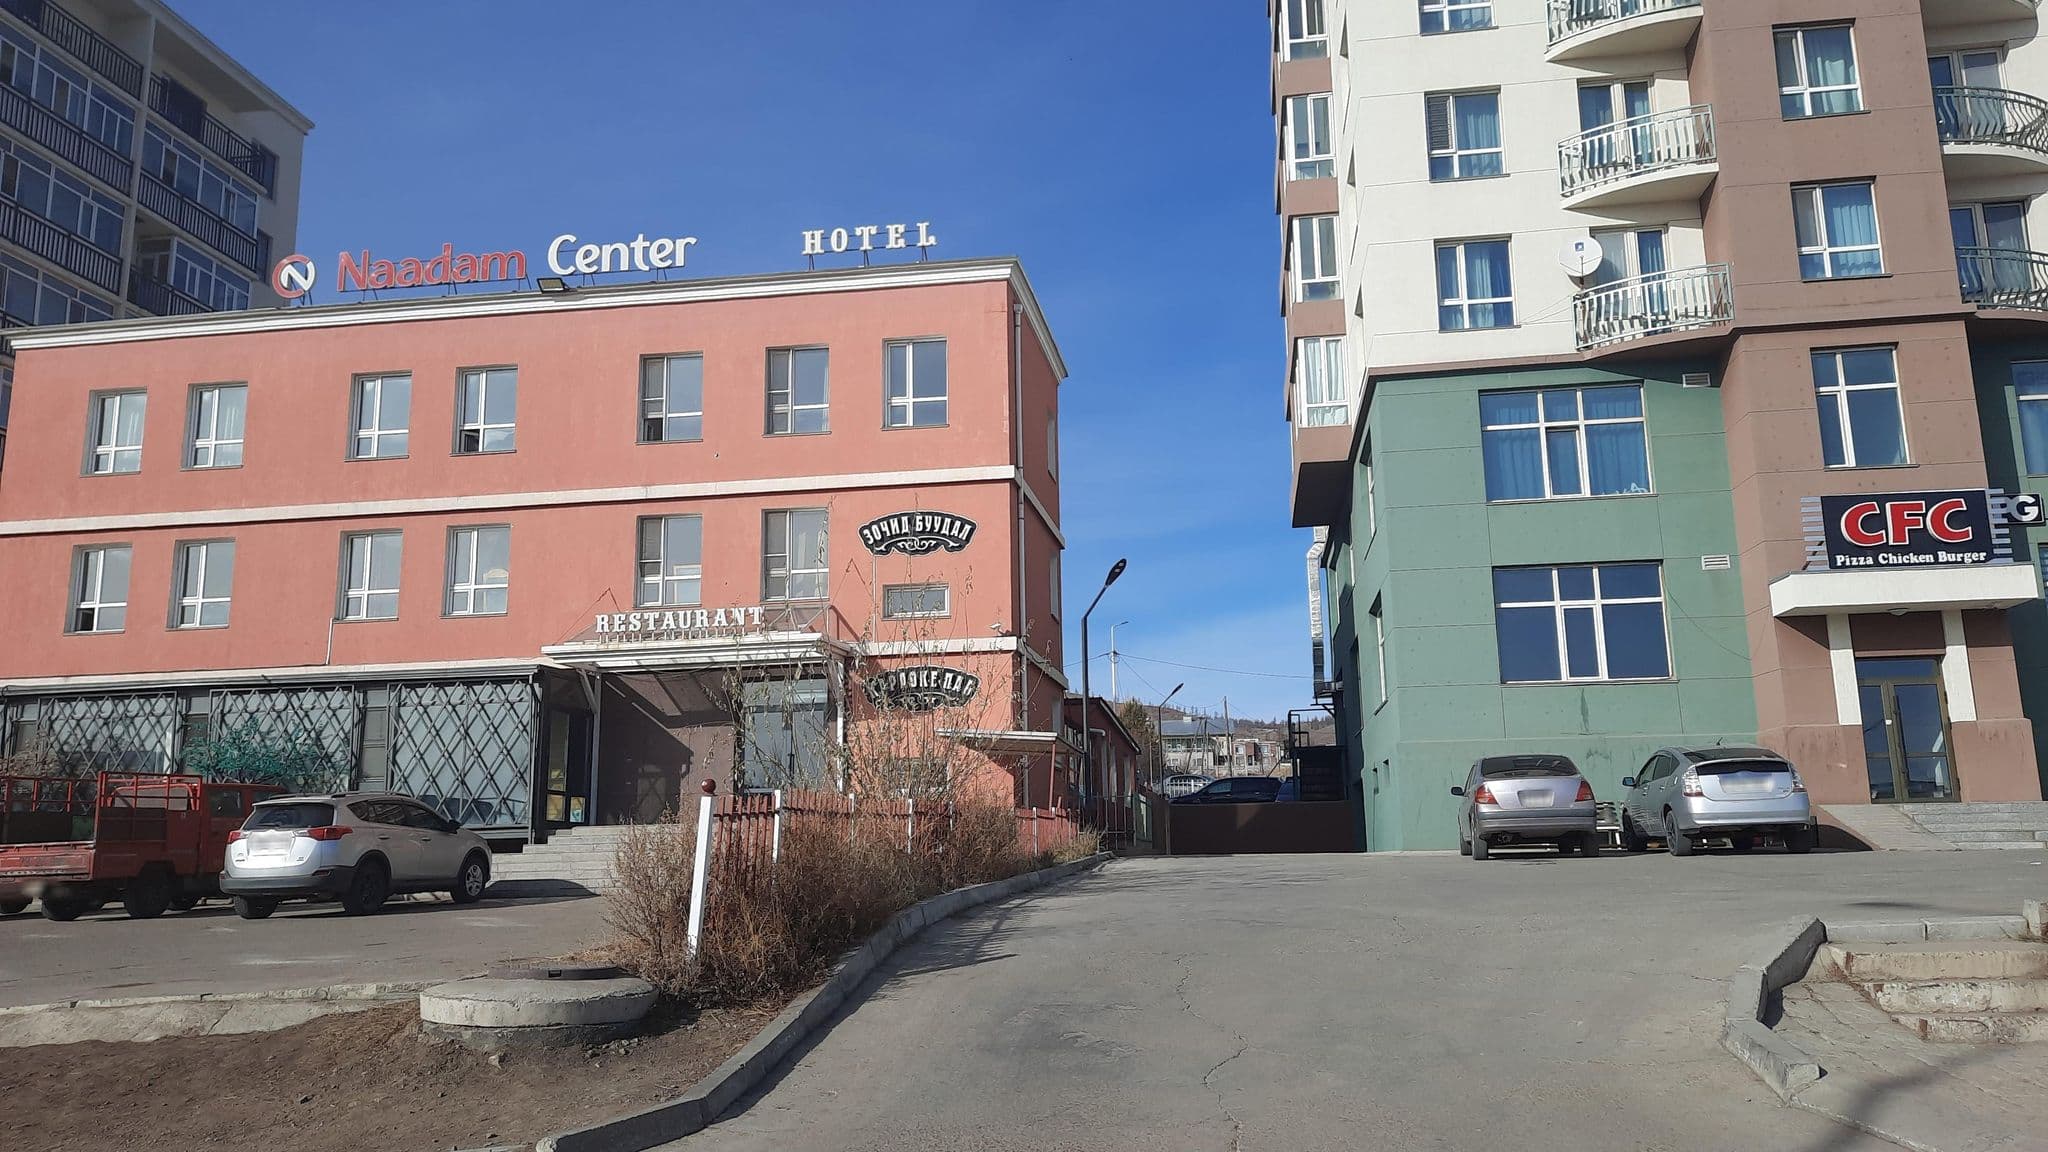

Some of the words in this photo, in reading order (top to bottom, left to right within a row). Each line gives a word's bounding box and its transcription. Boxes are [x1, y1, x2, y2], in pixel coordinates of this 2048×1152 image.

[801, 222, 938, 255] HOTEL
[337, 243, 527, 292] Naadam
[546, 233, 698, 276] Center
[862, 515, 910, 545] ЗОЧИД
[914, 515, 973, 541] БУУДАЛ
[1840, 497, 1974, 548] CFC
[1835, 554, 1874, 567] Pizza
[1878, 552, 1937, 565] Chicken
[1937, 550, 1987, 565] Burger
[596, 606, 764, 633] RESTAURANT
